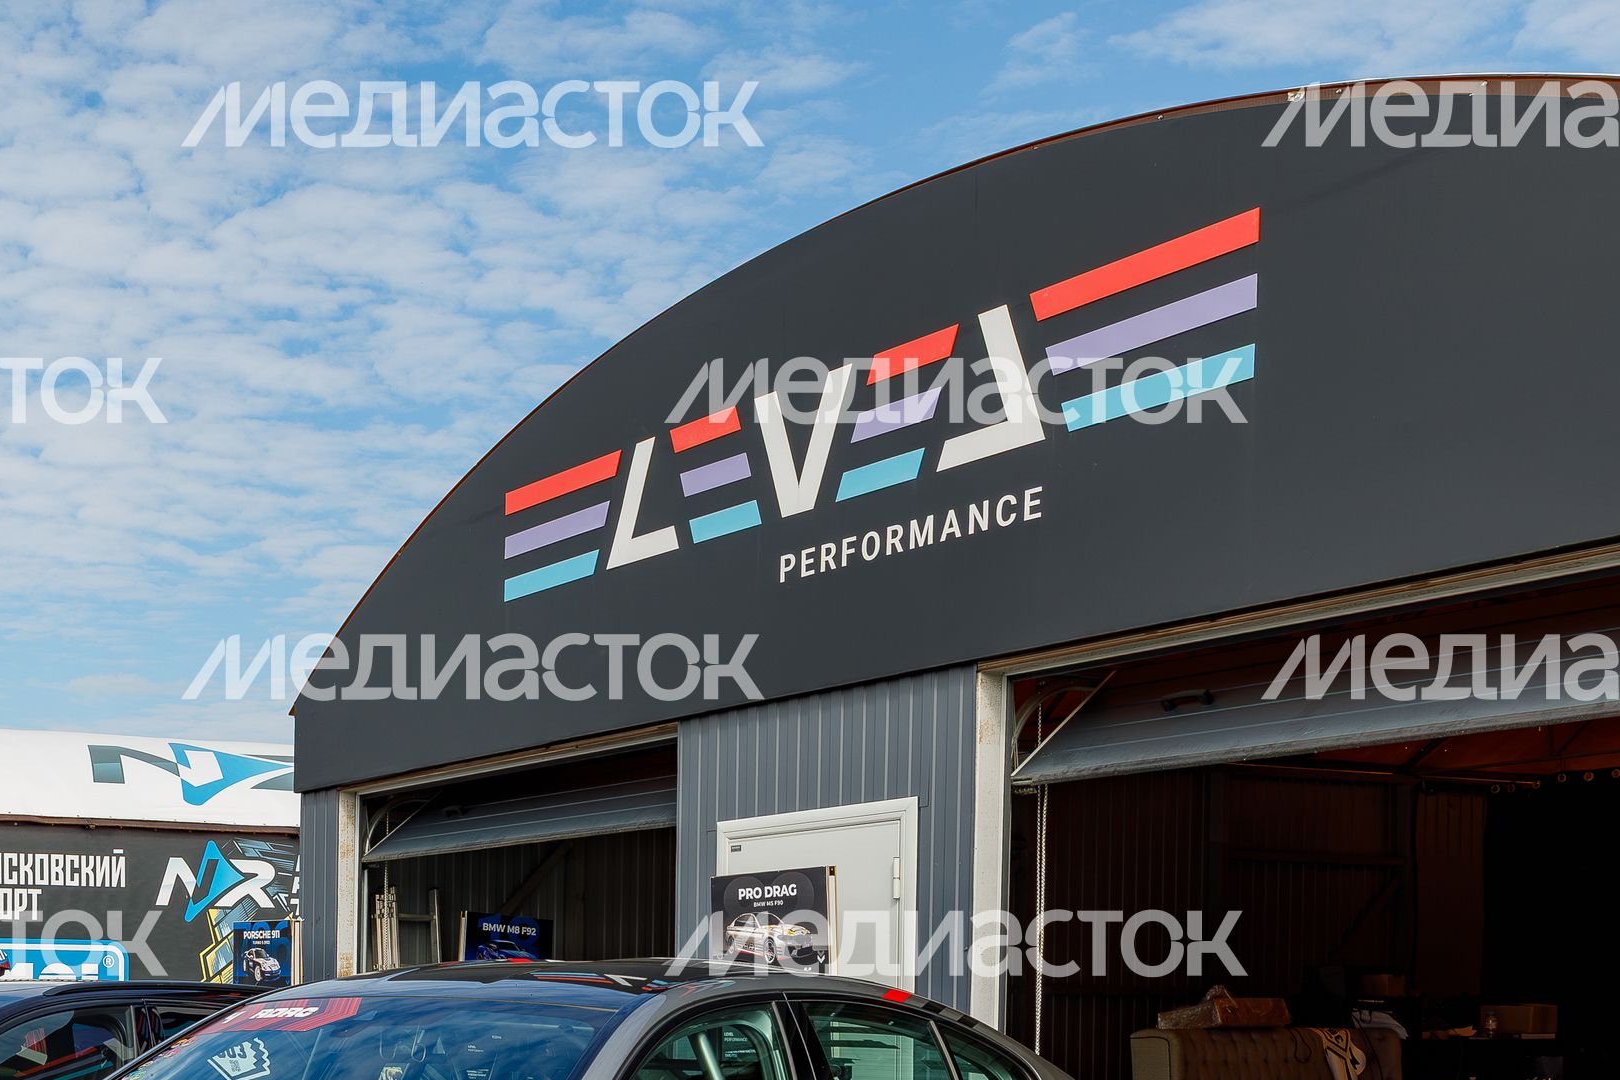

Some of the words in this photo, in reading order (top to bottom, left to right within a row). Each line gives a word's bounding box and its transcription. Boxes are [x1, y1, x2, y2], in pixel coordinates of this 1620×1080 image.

[779, 486, 1043, 582] PERFORMANCE
[738, 886, 762, 900] PRO
[765, 884, 797, 898] DRAG
[244, 930, 271, 939] PORSCHE
[272, 930, 280, 939] 911
[482, 923, 505, 932] BMW
[507, 925, 520, 934] M8
[521, 927, 536, 936] F92
